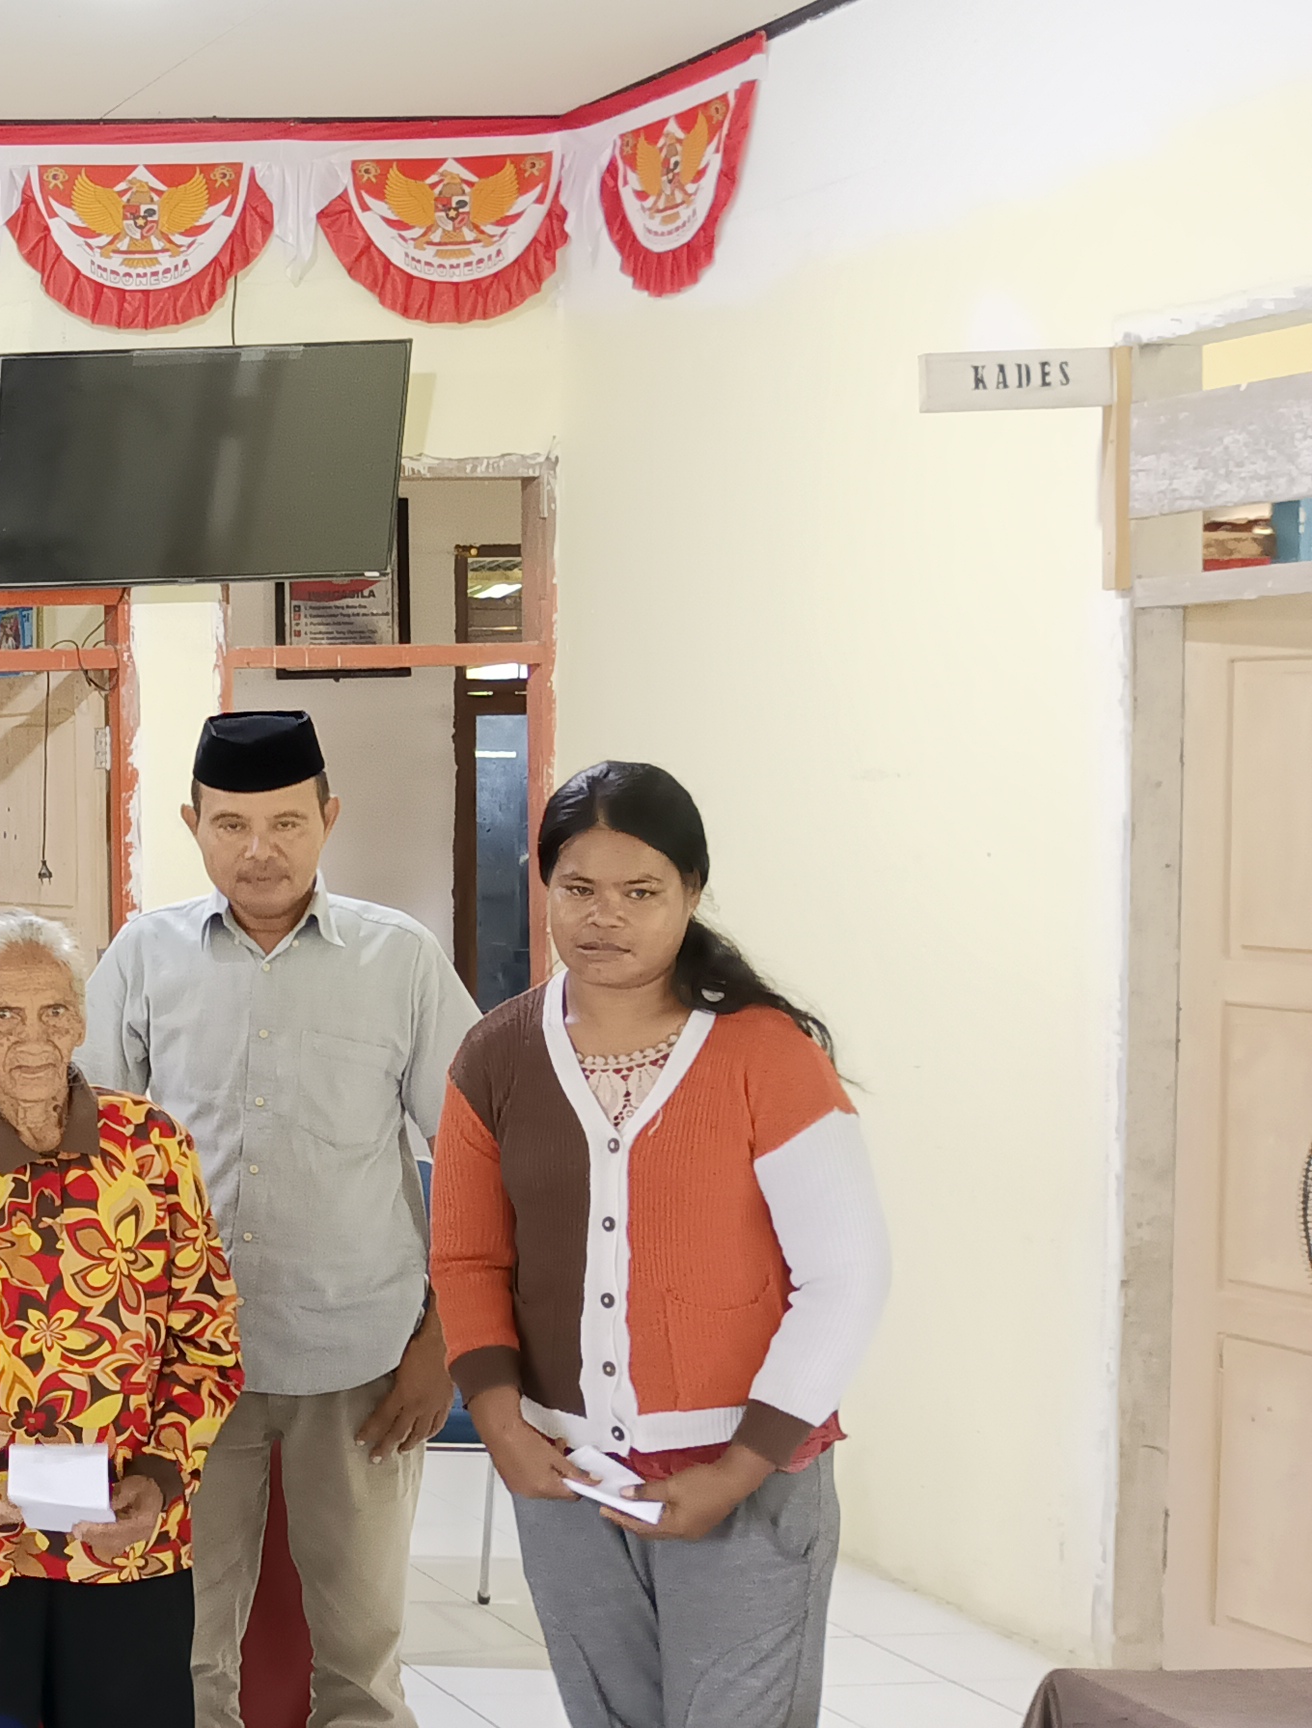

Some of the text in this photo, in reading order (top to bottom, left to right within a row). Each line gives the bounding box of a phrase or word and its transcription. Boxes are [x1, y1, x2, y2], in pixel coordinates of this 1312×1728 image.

[90, 259, 191, 290] INDONESIA
[403, 248, 506, 279] INDONESIA
[970, 361, 1072, 391] KADES
